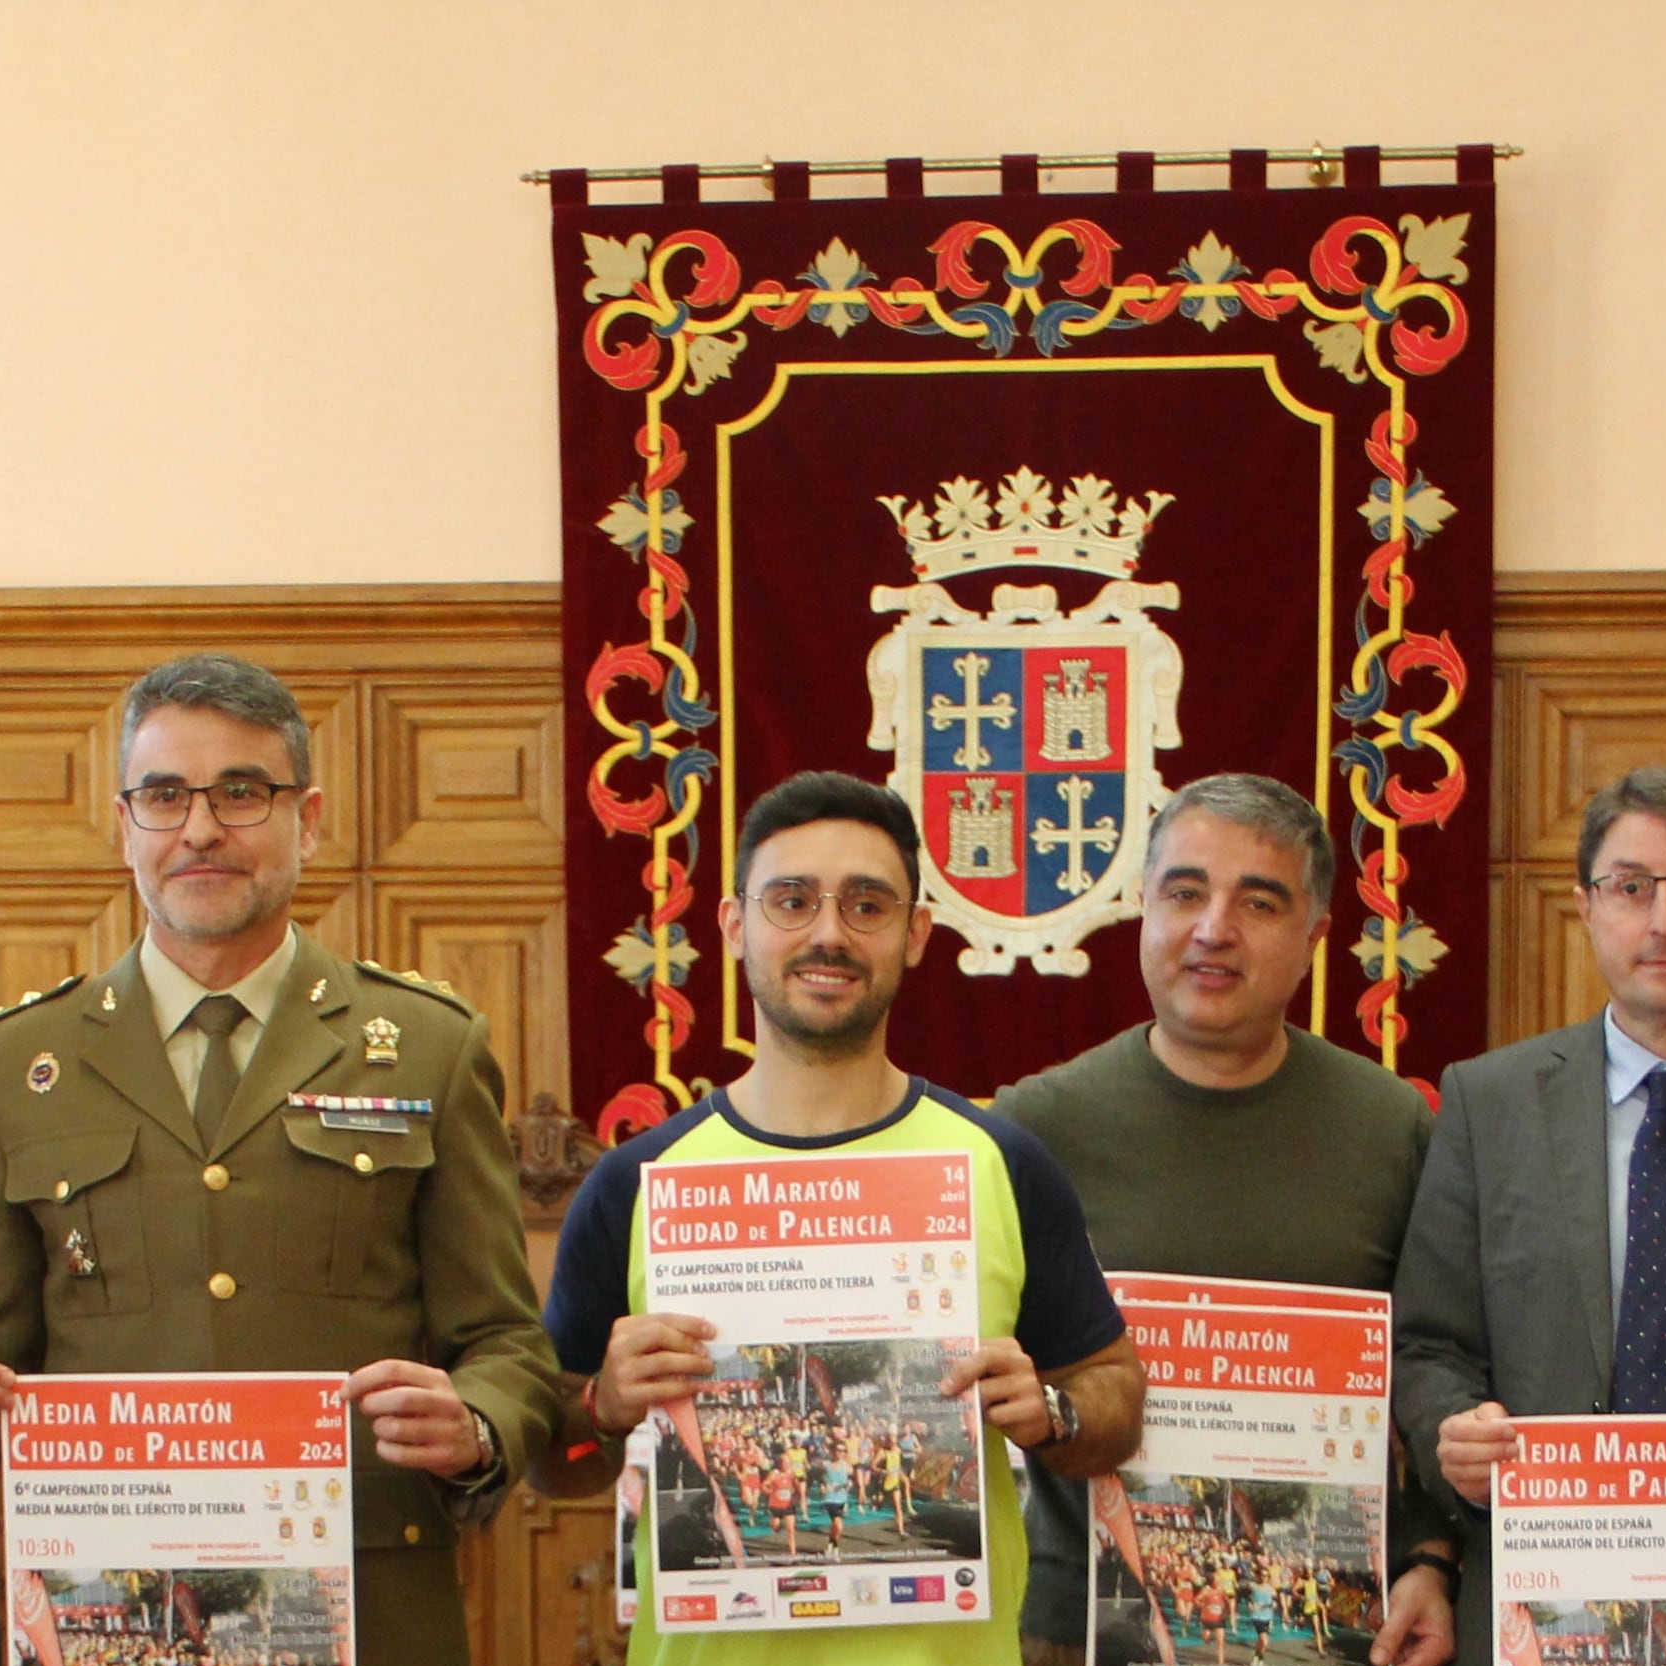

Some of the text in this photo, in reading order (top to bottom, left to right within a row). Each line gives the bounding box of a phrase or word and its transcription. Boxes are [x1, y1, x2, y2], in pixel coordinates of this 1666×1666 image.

[944, 1165, 965, 1183] 14
[651, 1173, 860, 1208] MEDIA MARATÓN
[940, 1190, 965, 1202] abril
[651, 1210, 892, 1245] CIUDAD DE PALENCIA
[926, 1214, 966, 1233] 2024
[671, 1262, 742, 1276] CAMPEONATO
[746, 1262, 758, 1273] DE
[762, 1260, 803, 1272] ESPAÑA
[656, 1276, 873, 1295] MEDIA MARATÓN DEL EJÉRCITO DE TIERRA
[1125, 1319, 1288, 1351] DIA MARATÓN
[1365, 1328, 1384, 1345] 14
[1361, 1351, 1383, 1362] abril
[1185, 1368, 1201, 1381] DE
[1213, 1356, 1315, 1386] PALENCIA
[1346, 1373, 1382, 1390] 2024
[11, 1392, 231, 1425] MEDIA MARATÓN
[319, 1392, 340, 1410] 14
[1180, 1400, 1232, 1412] DE ESPAÑA
[315, 1418, 340, 1429] abril
[1180, 1418, 1295, 1432] DEL EJÉRCITO DE TIERRA
[11, 1432, 264, 1463] CIUDAD DE PALENCIA
[300, 1443, 341, 1461] 2024
[33, 1484, 108, 1495] CAMPEONATO
[111, 1484, 125, 1495] DE
[128, 1483, 171, 1495] ESPAÑA
[1501, 1472, 1587, 1500] CIUDAD
[1599, 1484, 1616, 1497] DE
[17, 1502, 245, 1515] MEDIA MARATÓN DEL EJÉRCITO DE TIERRA
[1520, 1519, 1591, 1530] CAMPEONATO
[1595, 1519, 1607, 1529] DE
[1611, 1518, 1652, 1529] ESPAÑA
[16, 1538, 74, 1556] 10:30 h
[1505, 1539, 1537, 1549] MEDIA
[1540, 1537, 1591, 1548] MARATÓN
[1595, 1537, 1613, 1548] DEL
[1617, 1536, 1665, 1548] EJÉRCITO
[1504, 1570, 1558, 1588] 10:30 h
